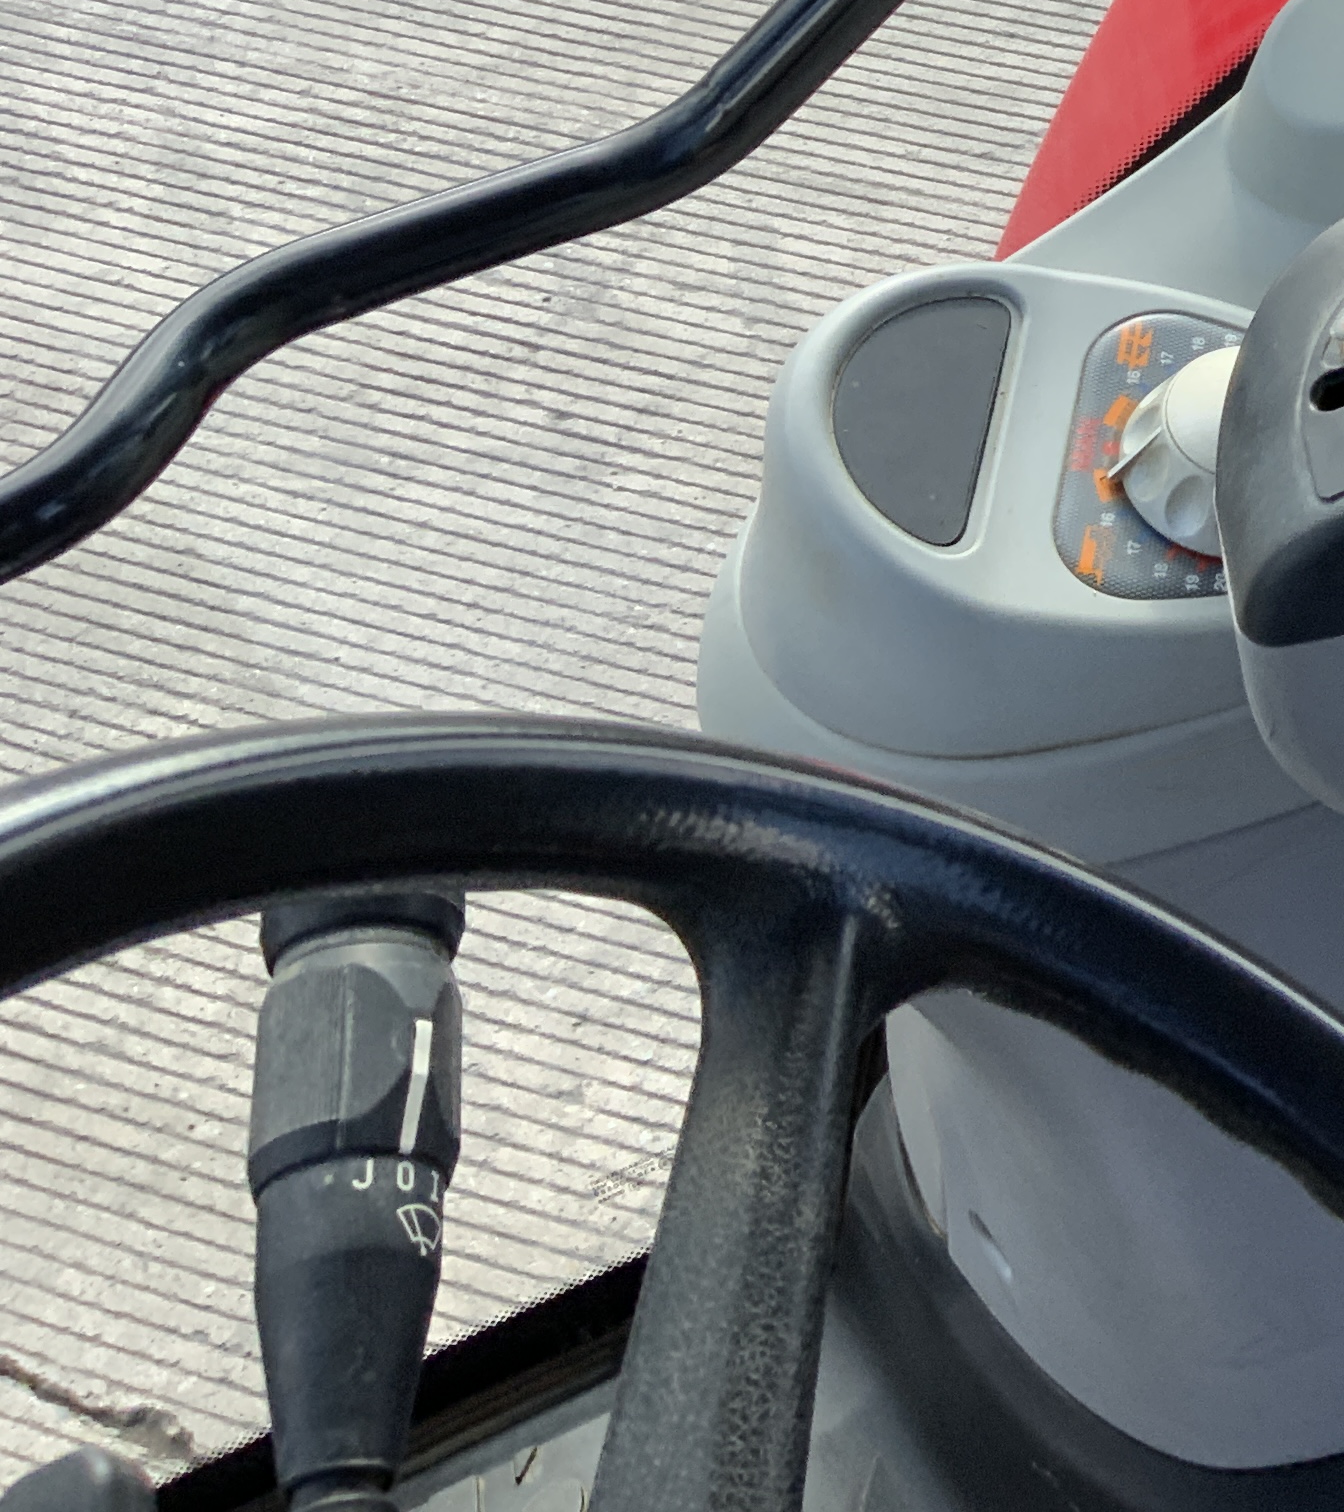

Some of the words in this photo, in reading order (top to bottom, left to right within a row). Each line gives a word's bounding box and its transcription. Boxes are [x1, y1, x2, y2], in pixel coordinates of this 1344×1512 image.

[1160, 351, 1174, 366] 17
[1100, 512, 1115, 527] 16
[1126, 540, 1143, 556] 17
[1185, 575, 1199, 590] 19
[352, 1159, 374, 1190] J
